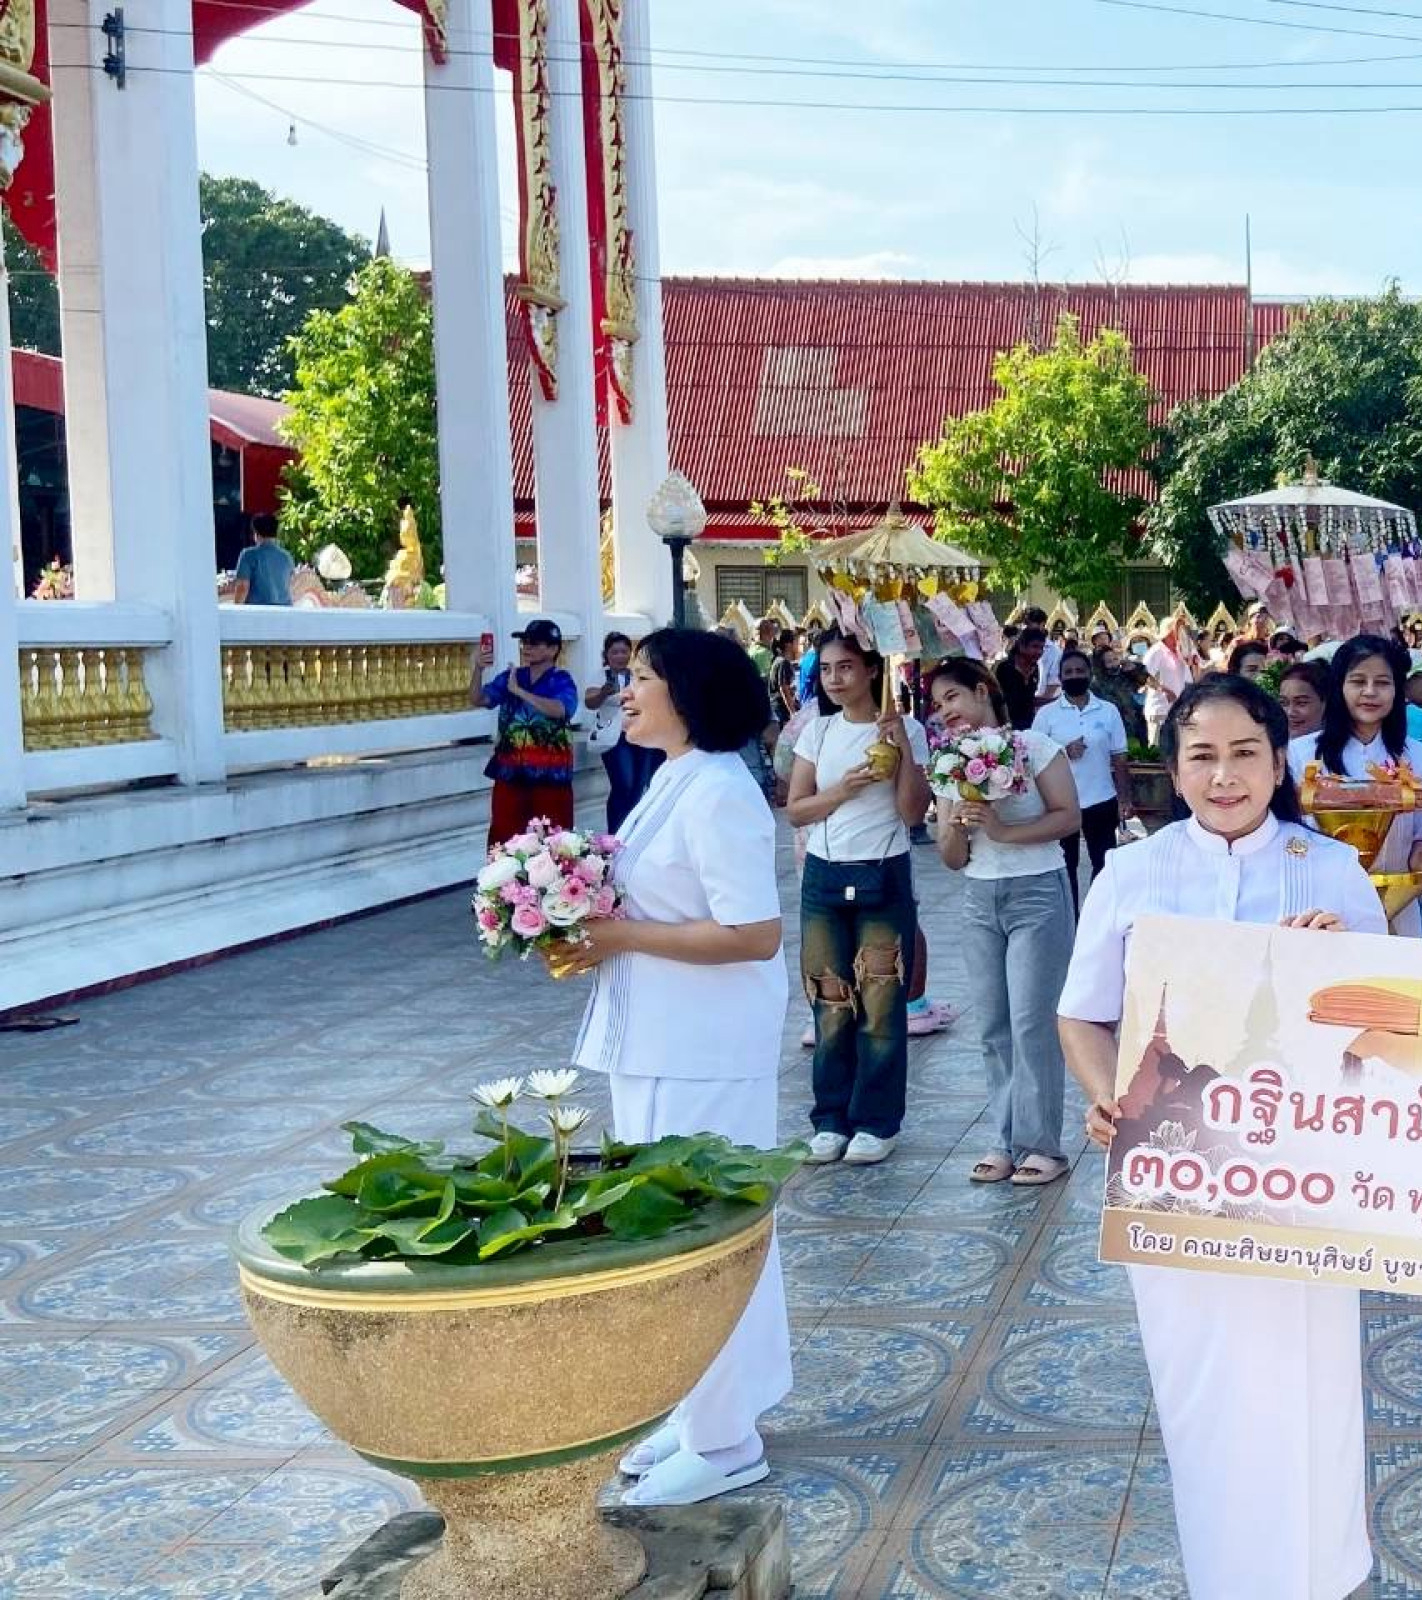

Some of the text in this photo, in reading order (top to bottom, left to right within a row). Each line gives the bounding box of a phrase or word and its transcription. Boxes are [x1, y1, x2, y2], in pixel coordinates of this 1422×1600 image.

[1128, 1154, 1336, 1206] ๓๐,๐๐๐
[1351, 1170, 1396, 1212] วัด
[1129, 1225, 1173, 1252] โดย
[1184, 1237, 1374, 1275] คณะศิษยานุศิษย์
